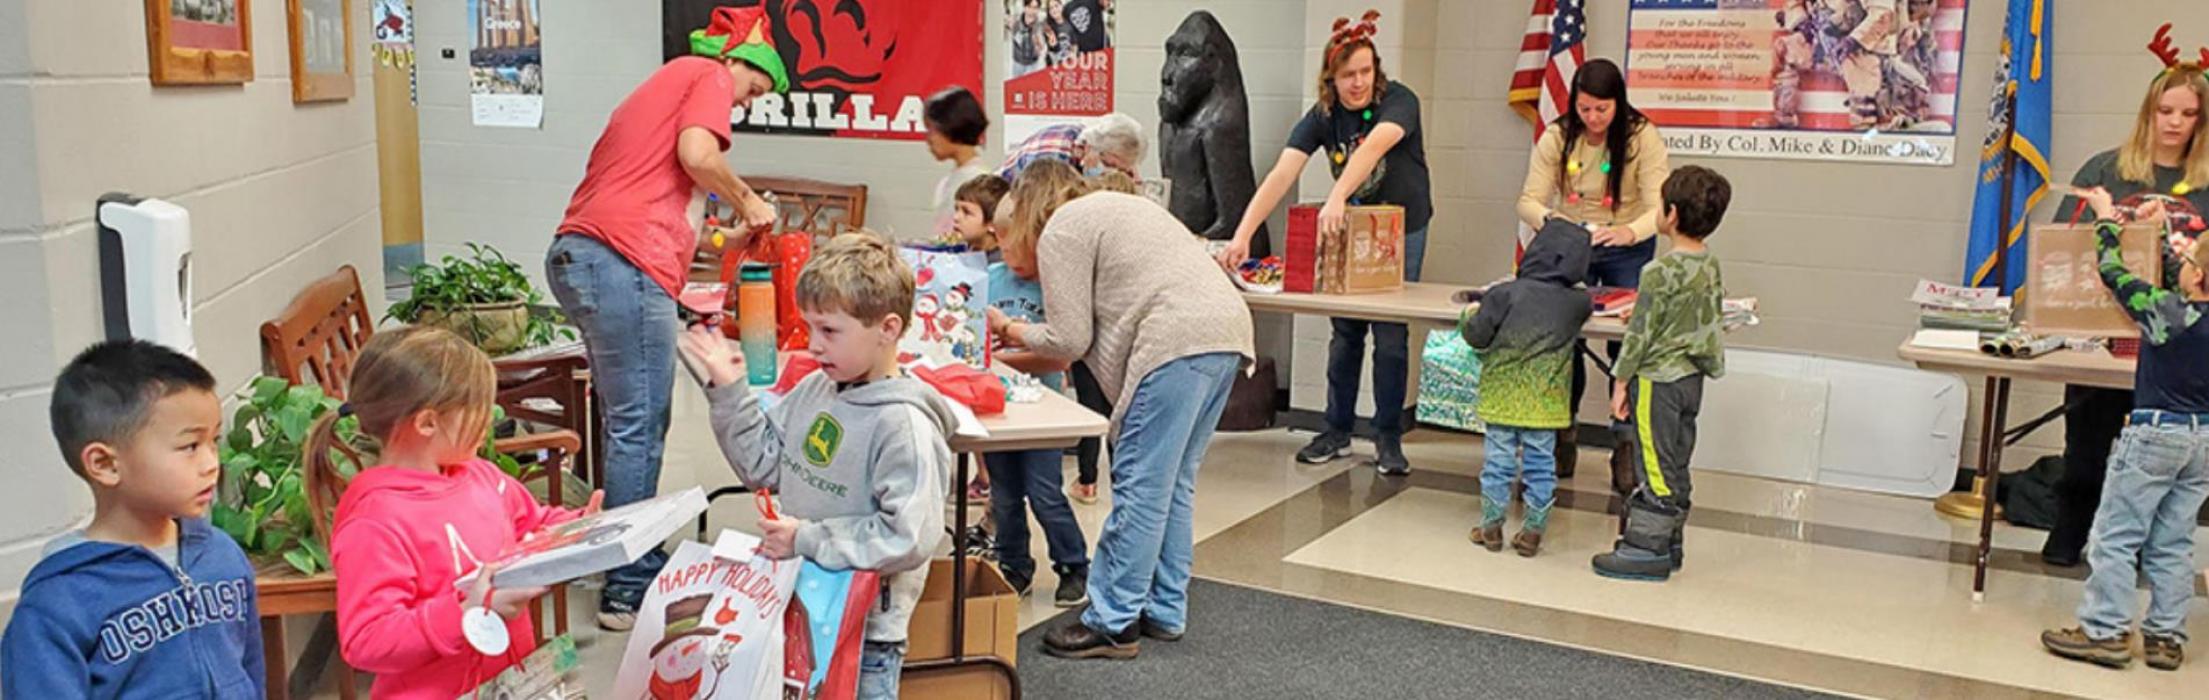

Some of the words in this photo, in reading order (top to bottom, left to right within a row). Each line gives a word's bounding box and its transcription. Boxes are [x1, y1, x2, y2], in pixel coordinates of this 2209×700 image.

[485, 17, 521, 29] Greece
[1050, 51, 1108, 71] YOUR
[1049, 71, 1108, 90] YEAR
[1028, 91, 1047, 110] IS
[1051, 91, 1108, 111] HERE
[1700, 134, 1720, 154] By
[1727, 135, 1764, 152] Col.
[1768, 136, 1813, 154] Mike
[1818, 139, 1834, 154] &
[658, 561, 723, 594] HAPPY
[720, 563, 780, 619] HOLIDAYS
